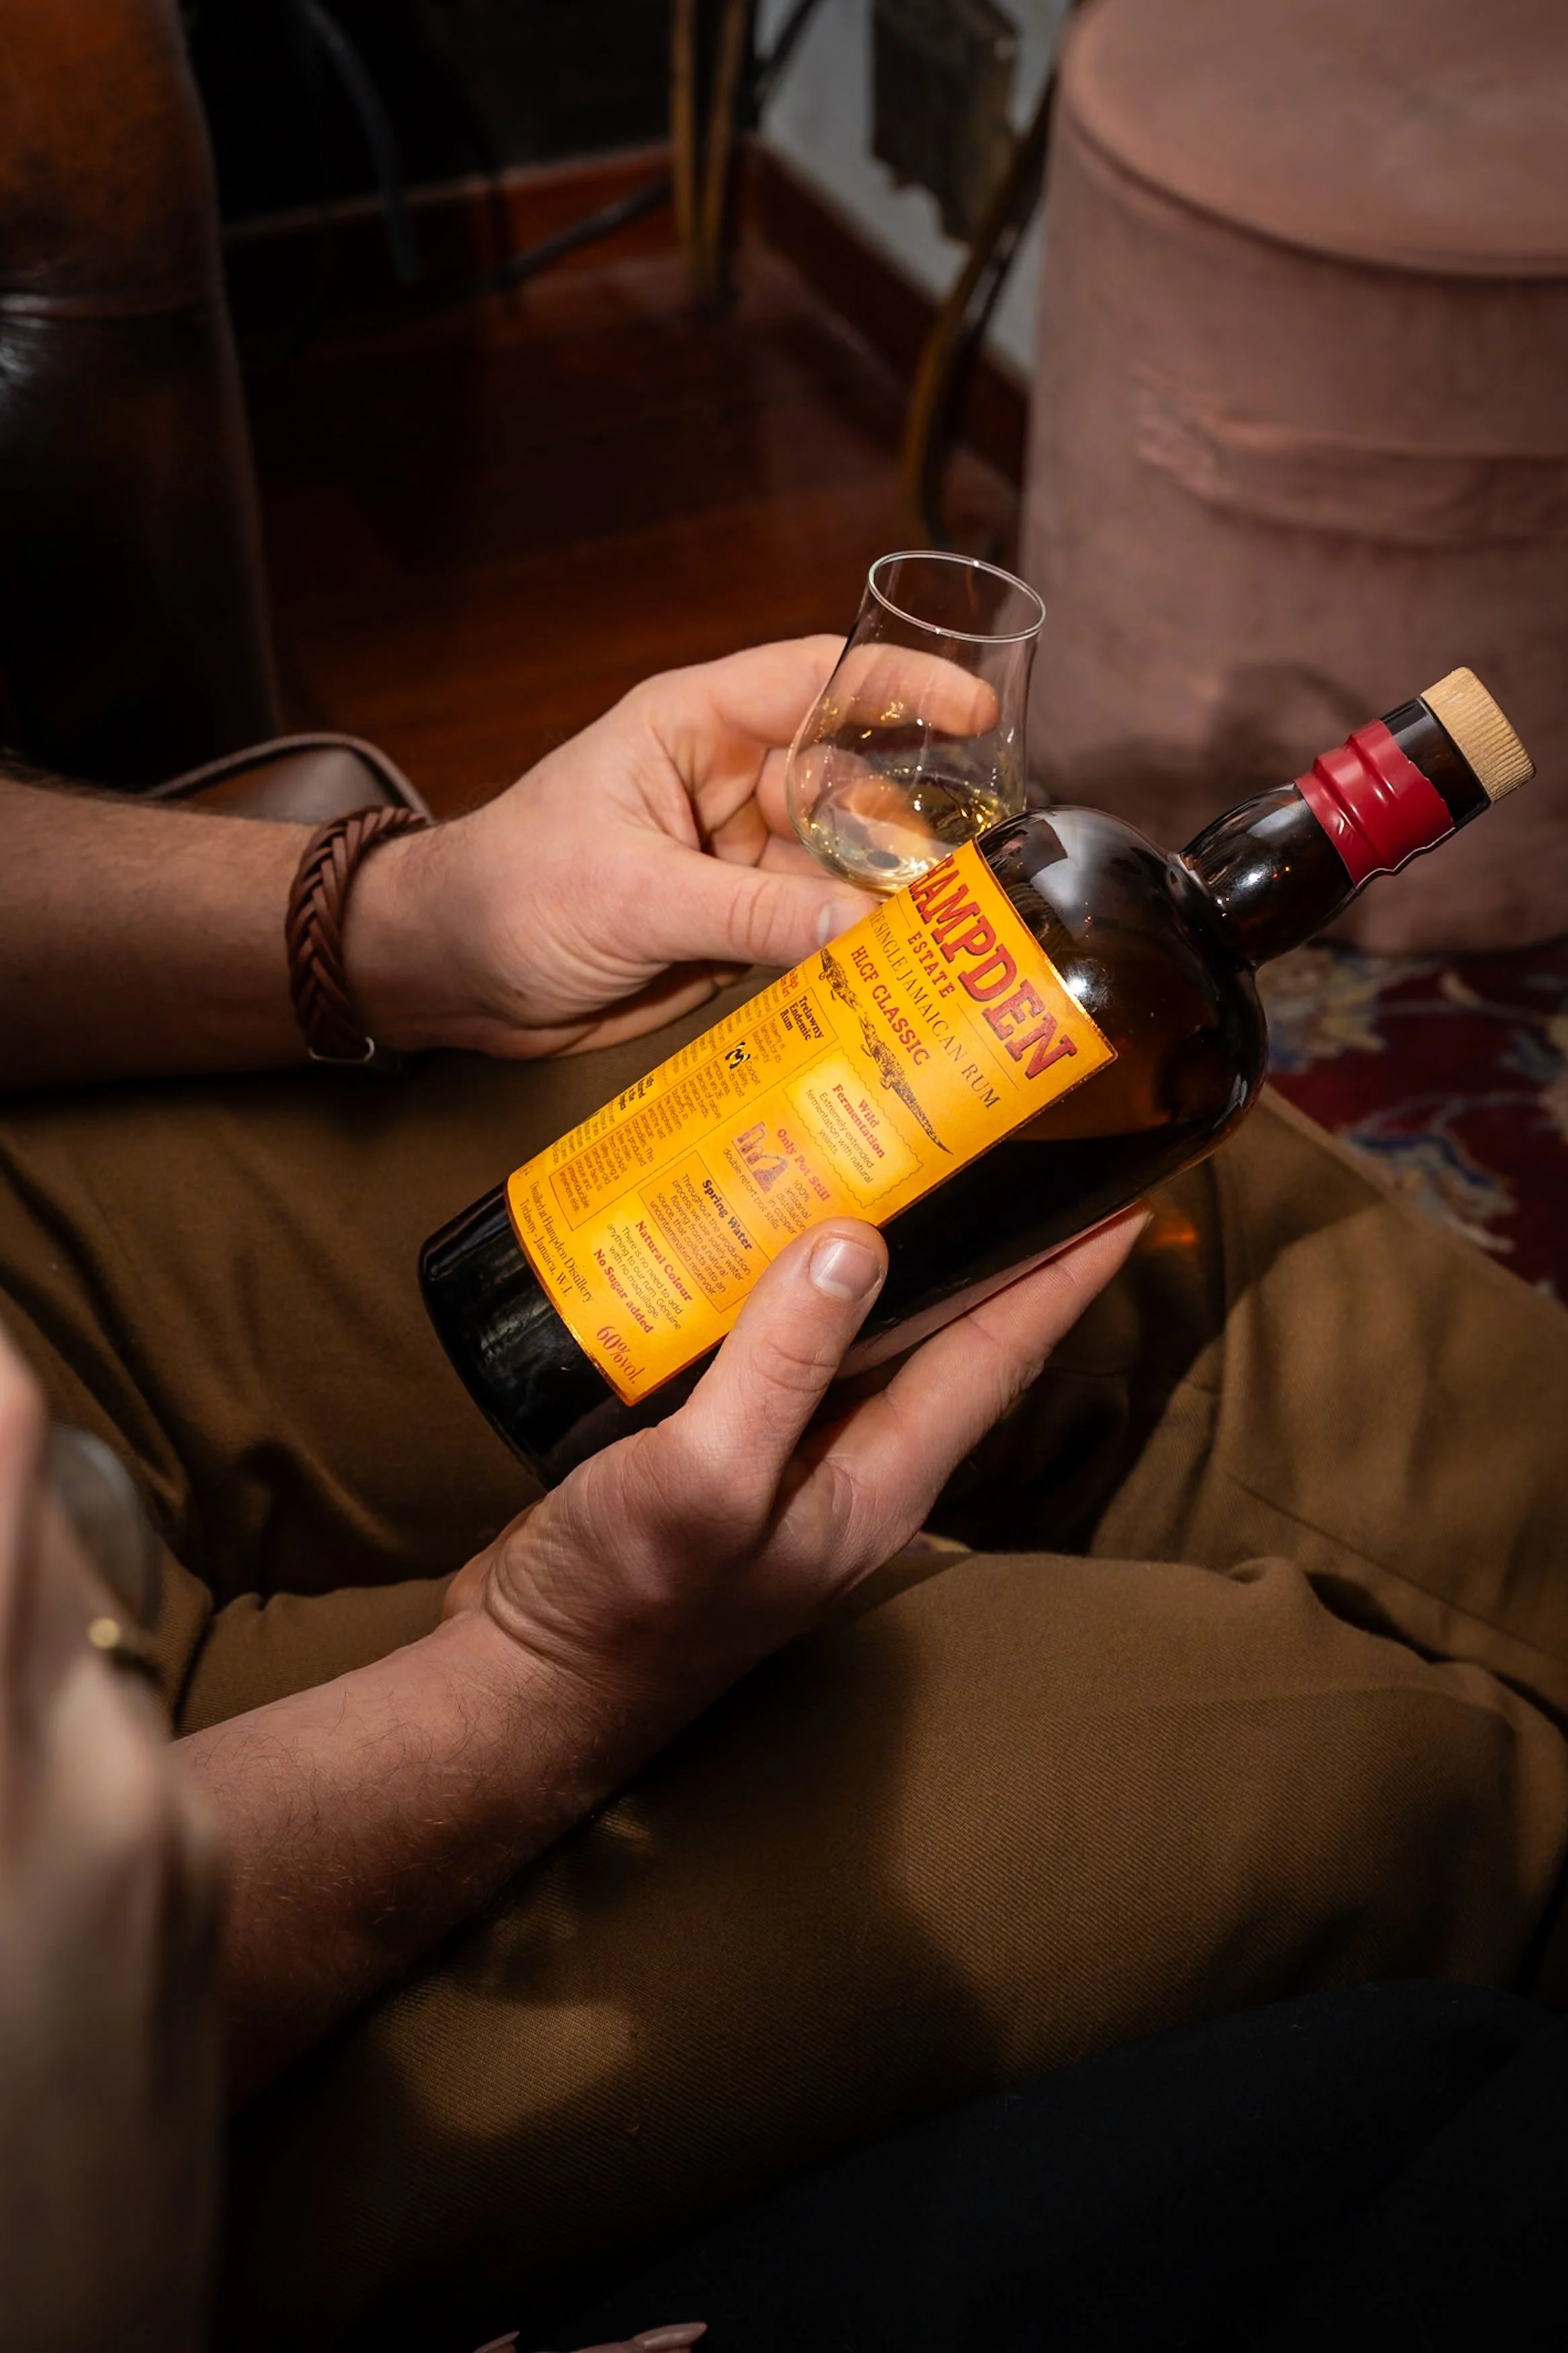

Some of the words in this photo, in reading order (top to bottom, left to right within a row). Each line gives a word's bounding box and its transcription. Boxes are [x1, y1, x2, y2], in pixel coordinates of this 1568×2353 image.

[907, 930, 955, 998] ESTATE
[780, 1008, 793, 1031] Rum
[789, 1002, 812, 1041] Endemic
[798, 995, 824, 1039] Trelawny
[850, 945, 879, 983] HLCF
[871, 984, 930, 1066] CLASSIC
[873, 922, 907, 971] SINGLE
[896, 968, 968, 1064] JAMAICAN
[960, 1064, 1001, 1110] RUM
[805, 1088, 840, 1138] fermentation
[837, 1138, 853, 1156] with
[850, 1156, 874, 1183] natural
[819, 1091, 848, 1131] Extremely
[845, 1131, 875, 1168] extended
[831, 1084, 886, 1158] Fermentation
[856, 1099, 880, 1128] Wild
[722, 1147, 742, 1174] double
[739, 1174, 757, 1197] retort
[753, 1196, 768, 1213] pot
[776, 1128, 797, 1155] Only
[794, 1154, 811, 1176] Pot
[808, 1176, 831, 1201] Still
[519, 1197, 537, 1234] Trelawny
[533, 1235, 557, 1275] Jamaica,
[538, 1209, 547, 1219] at
[542, 1215, 568, 1260] Hampden
[649, 1199, 692, 1262] uncontaminated
[669, 1195, 690, 1225] flowing
[688, 1223, 704, 1244] from
[705, 1249, 729, 1278] natural
[671, 1179, 693, 1209] process
[690, 1208, 700, 1222] we
[698, 1221, 710, 1236] use
[708, 1236, 727, 1259] solely
[725, 1259, 744, 1281] water
[680, 1172, 711, 1218] Throughout
[708, 1218, 721, 1233] the
[717, 1232, 752, 1276] production
[701, 1179, 729, 1218] Spring
[727, 1216, 753, 1250] Water
[773, 1207, 797, 1234] copper
[776, 1192, 809, 1233] distillation
[784, 1187, 812, 1220] artisanal
[563, 1257, 593, 1303] Distillery
[593, 1248, 607, 1267] No
[603, 1266, 628, 1300] Sugar
[625, 1300, 654, 1333] added
[606, 1223, 630, 1257] anything
[626, 1255, 636, 1266] to
[632, 1265, 645, 1279] our
[655, 1298, 682, 1330] Genuine
[609, 1245, 622, 1264] with
[619, 1263, 630, 1275] no
[621, 1225, 637, 1250] There
[634, 1248, 642, 1257] is
[638, 1257, 649, 1268] no
[646, 1267, 665, 1289] need
[661, 1287, 670, 1299] to
[667, 1298, 684, 1314] add
[634, 1220, 666, 1264] Natural
[663, 1264, 693, 1302] Colour
[672, 1218, 687, 1236] that
[683, 1236, 707, 1267] collects
[704, 1265, 718, 1281] into
[715, 1281, 727, 1293] an
